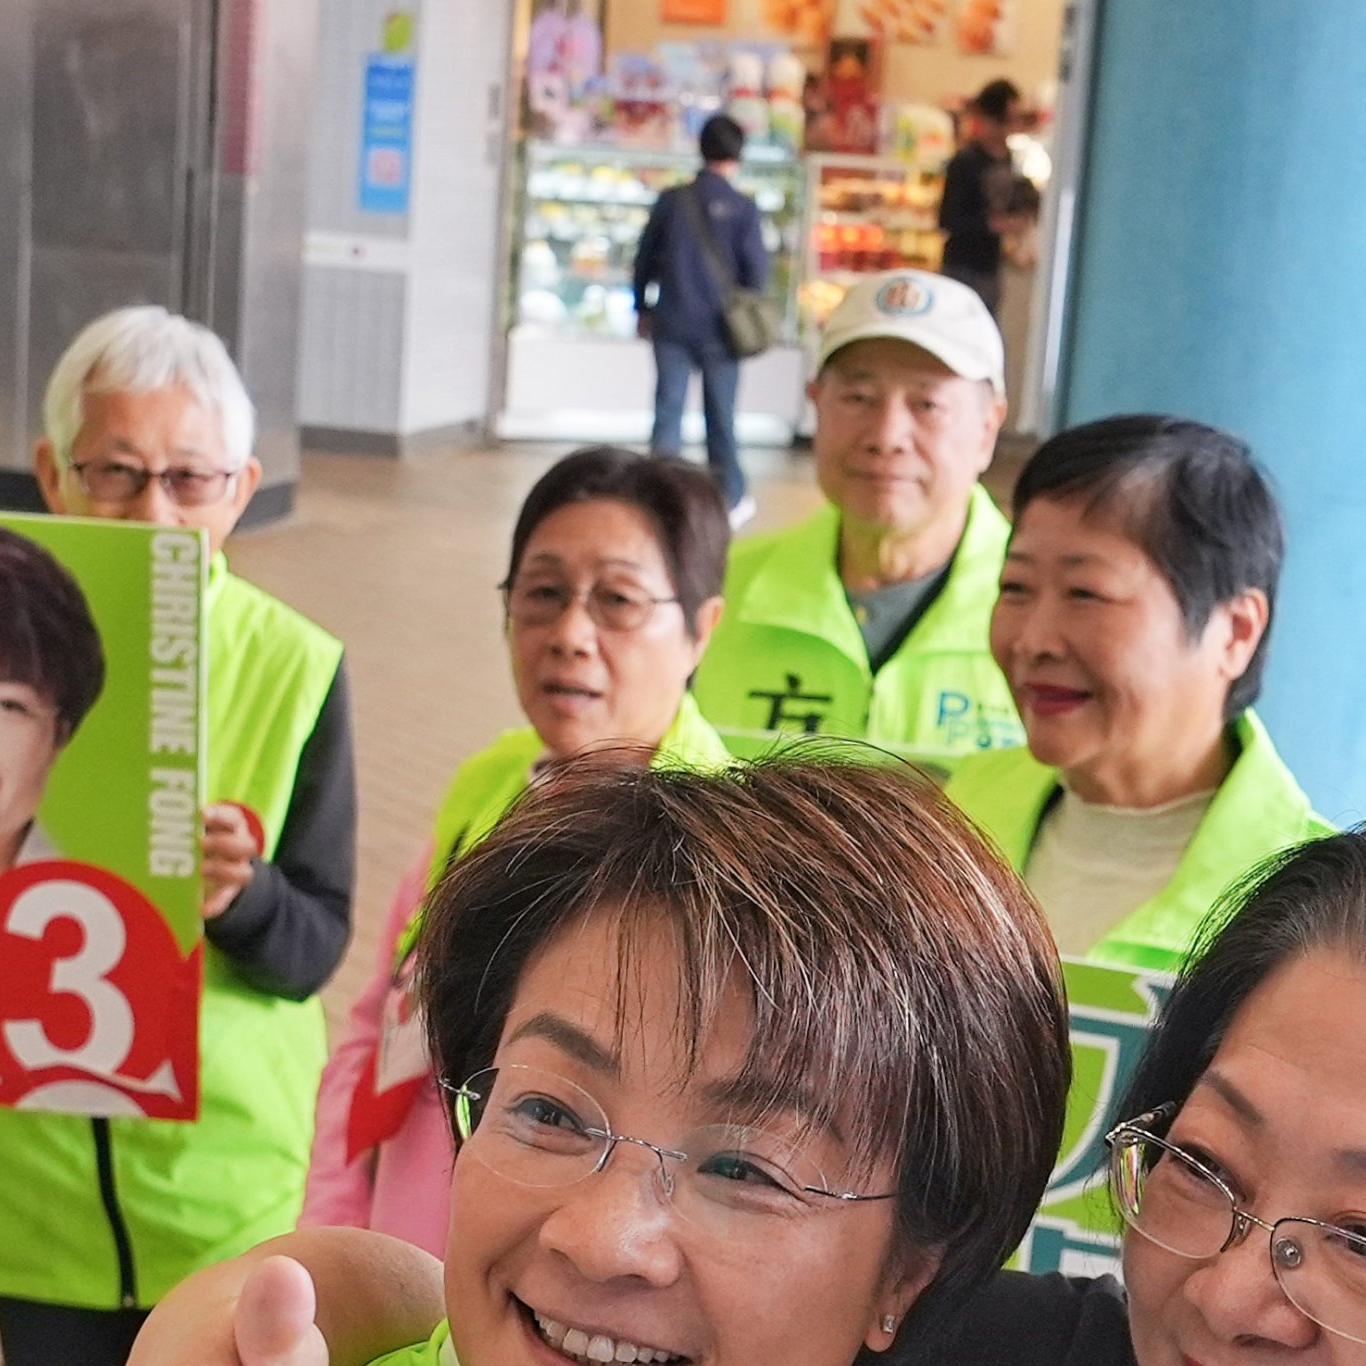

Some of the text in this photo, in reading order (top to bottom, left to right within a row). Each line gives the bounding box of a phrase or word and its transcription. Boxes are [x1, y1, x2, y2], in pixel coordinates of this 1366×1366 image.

[148, 532, 199, 878] CHRISTINE FONG
[1, 878, 136, 1075] 3
